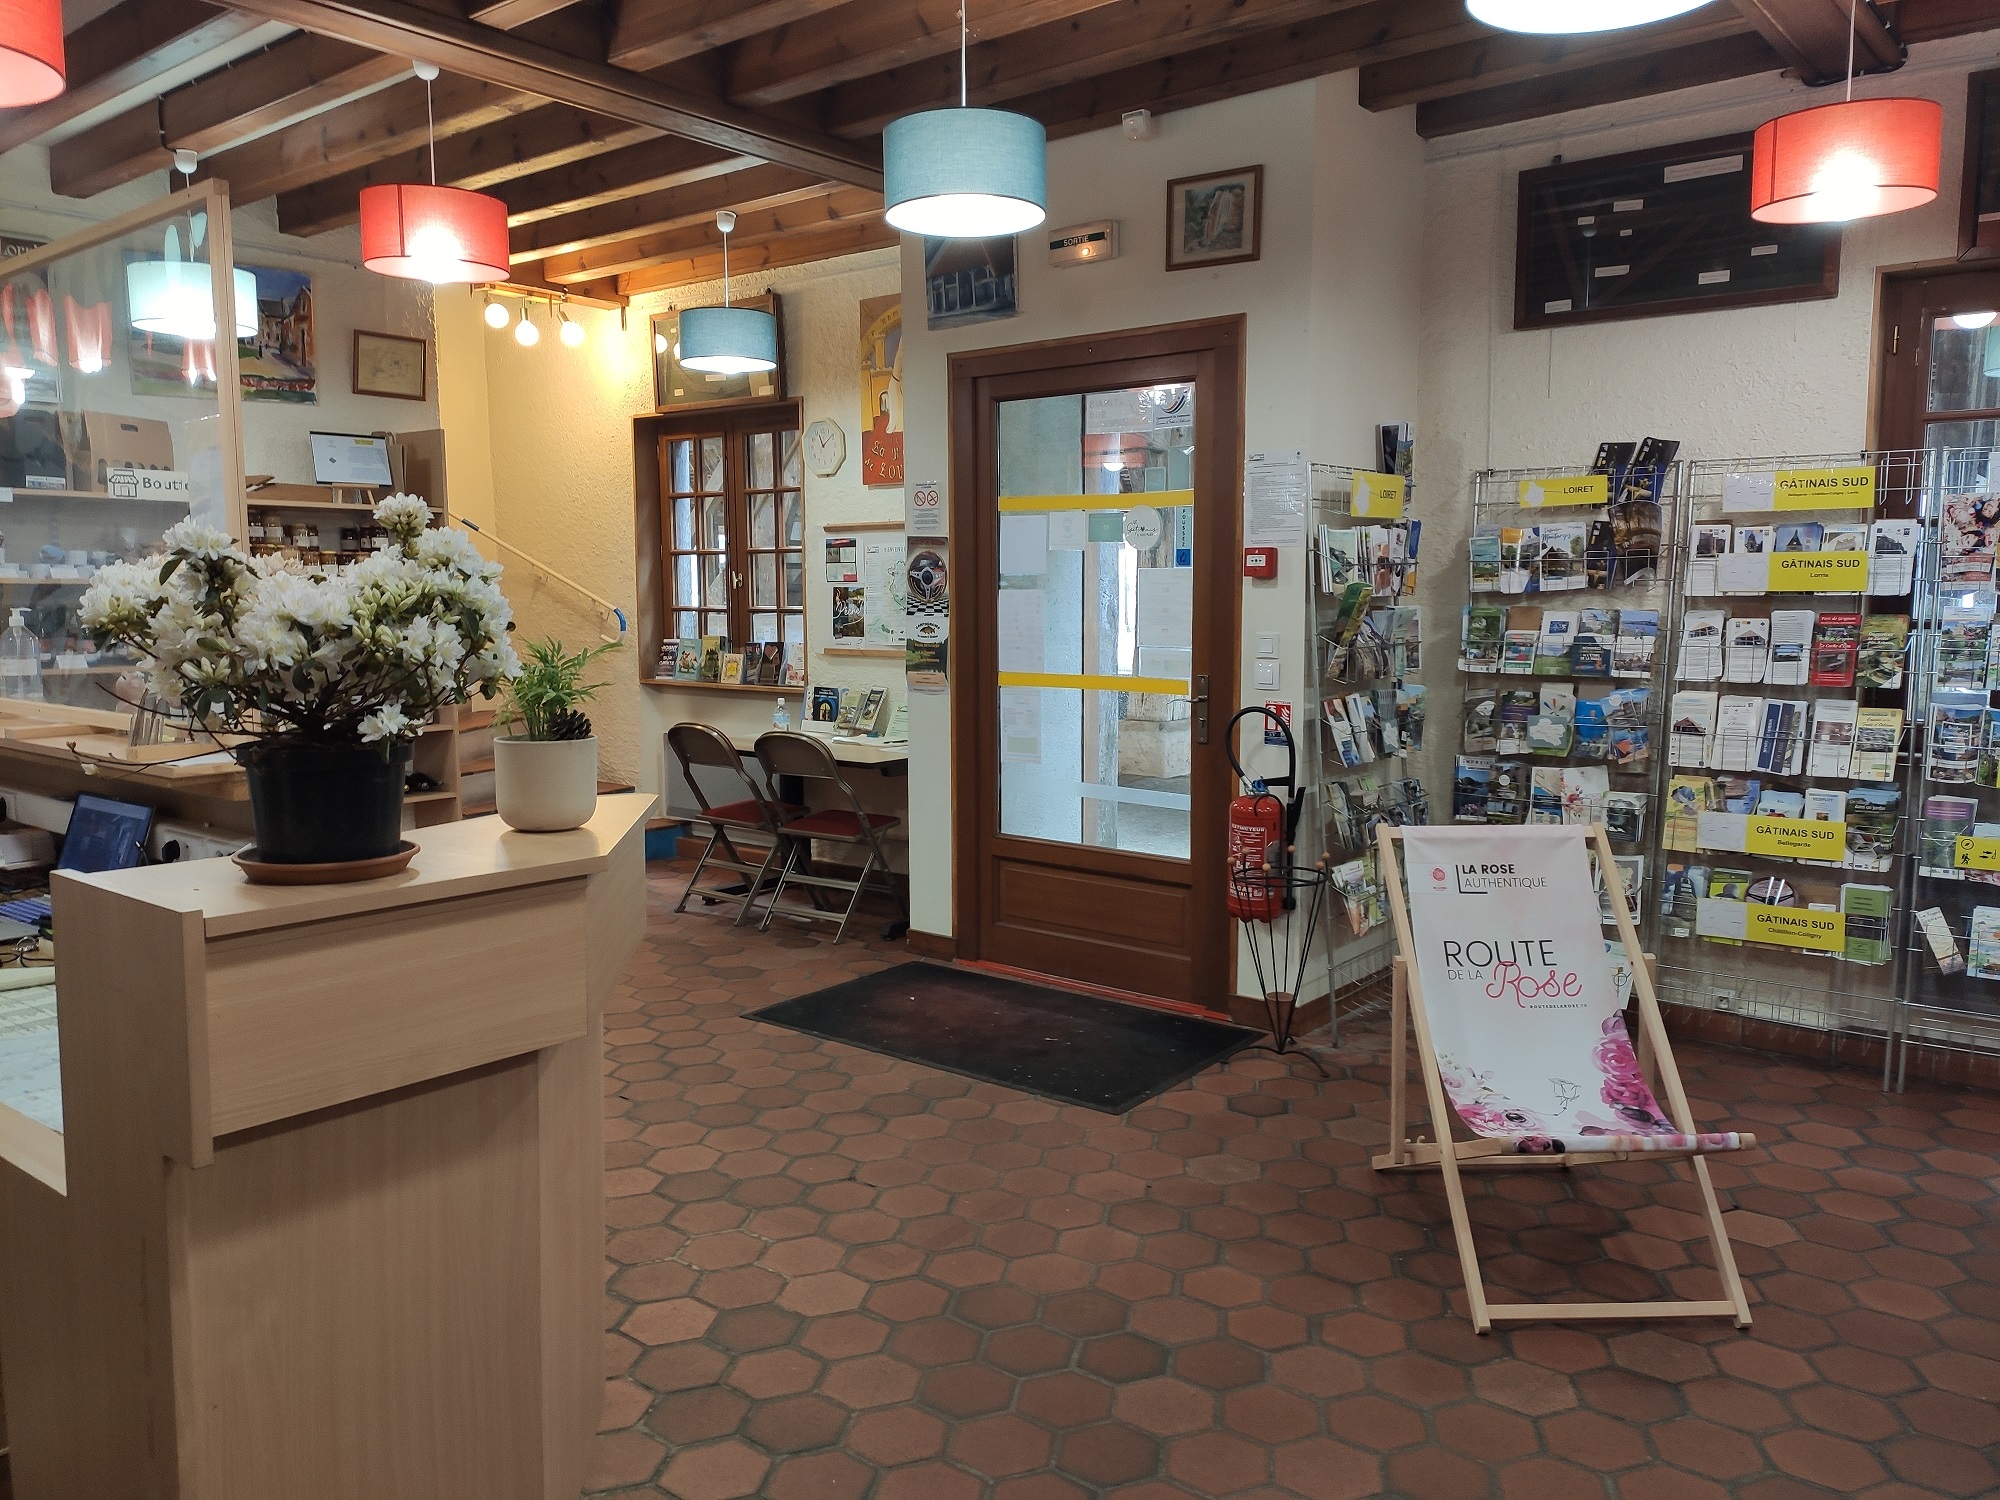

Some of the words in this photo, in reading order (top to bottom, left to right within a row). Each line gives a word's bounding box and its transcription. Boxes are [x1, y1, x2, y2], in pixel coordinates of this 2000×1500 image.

[1063, 235, 1089, 247] SORTIE
[1780, 477, 1838, 490] GÂTINAIS
[1842, 476, 1869, 487] SUD
[1380, 490, 1397, 499] LOIRET
[1563, 485, 1594, 494] LOIRET
[1781, 558, 1833, 569] GÂTINAIS
[1836, 559, 1860, 568] SUD
[1756, 825, 1808, 838] GÂTINAIS
[1811, 830, 1834, 840] SUD
[1777, 839, 1812, 848] Bellegarde
[1462, 864, 1478, 875] LA
[1481, 864, 1515, 875] ROSE
[1464, 877, 1548, 890] AUTHENTIQUE
[1757, 914, 1808, 928] GÂTINAIS
[1811, 920, 1835, 931] SUD
[1768, 927, 1823, 940] Châtillon-Coligny
[1443, 939, 1557, 968] ROUTE
[1447, 969, 1464, 981] DE
[1467, 969, 1484, 981] LA
[1486, 960, 1583, 1009] Rose
